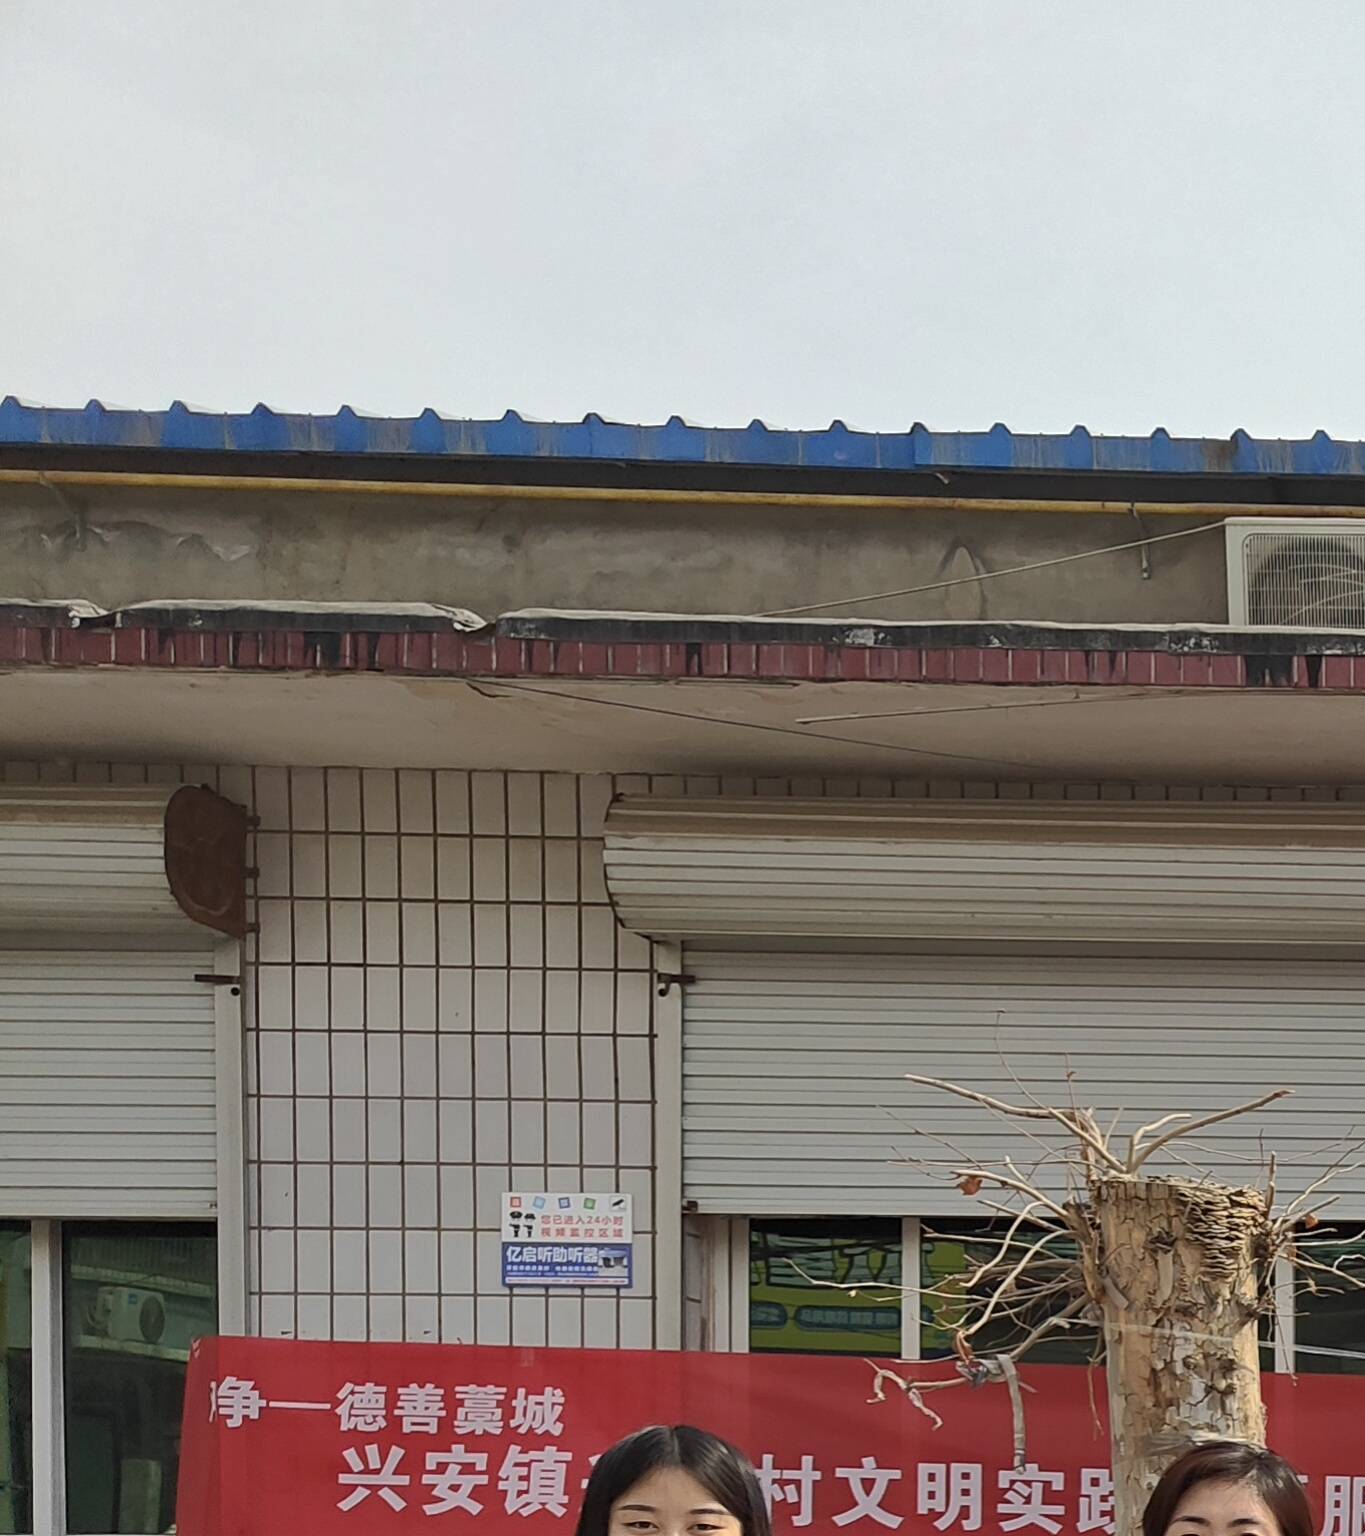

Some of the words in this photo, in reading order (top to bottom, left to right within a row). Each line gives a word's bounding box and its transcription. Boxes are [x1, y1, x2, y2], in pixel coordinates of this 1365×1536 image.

[506, 1246, 599, 1263] 亿启听助听器
